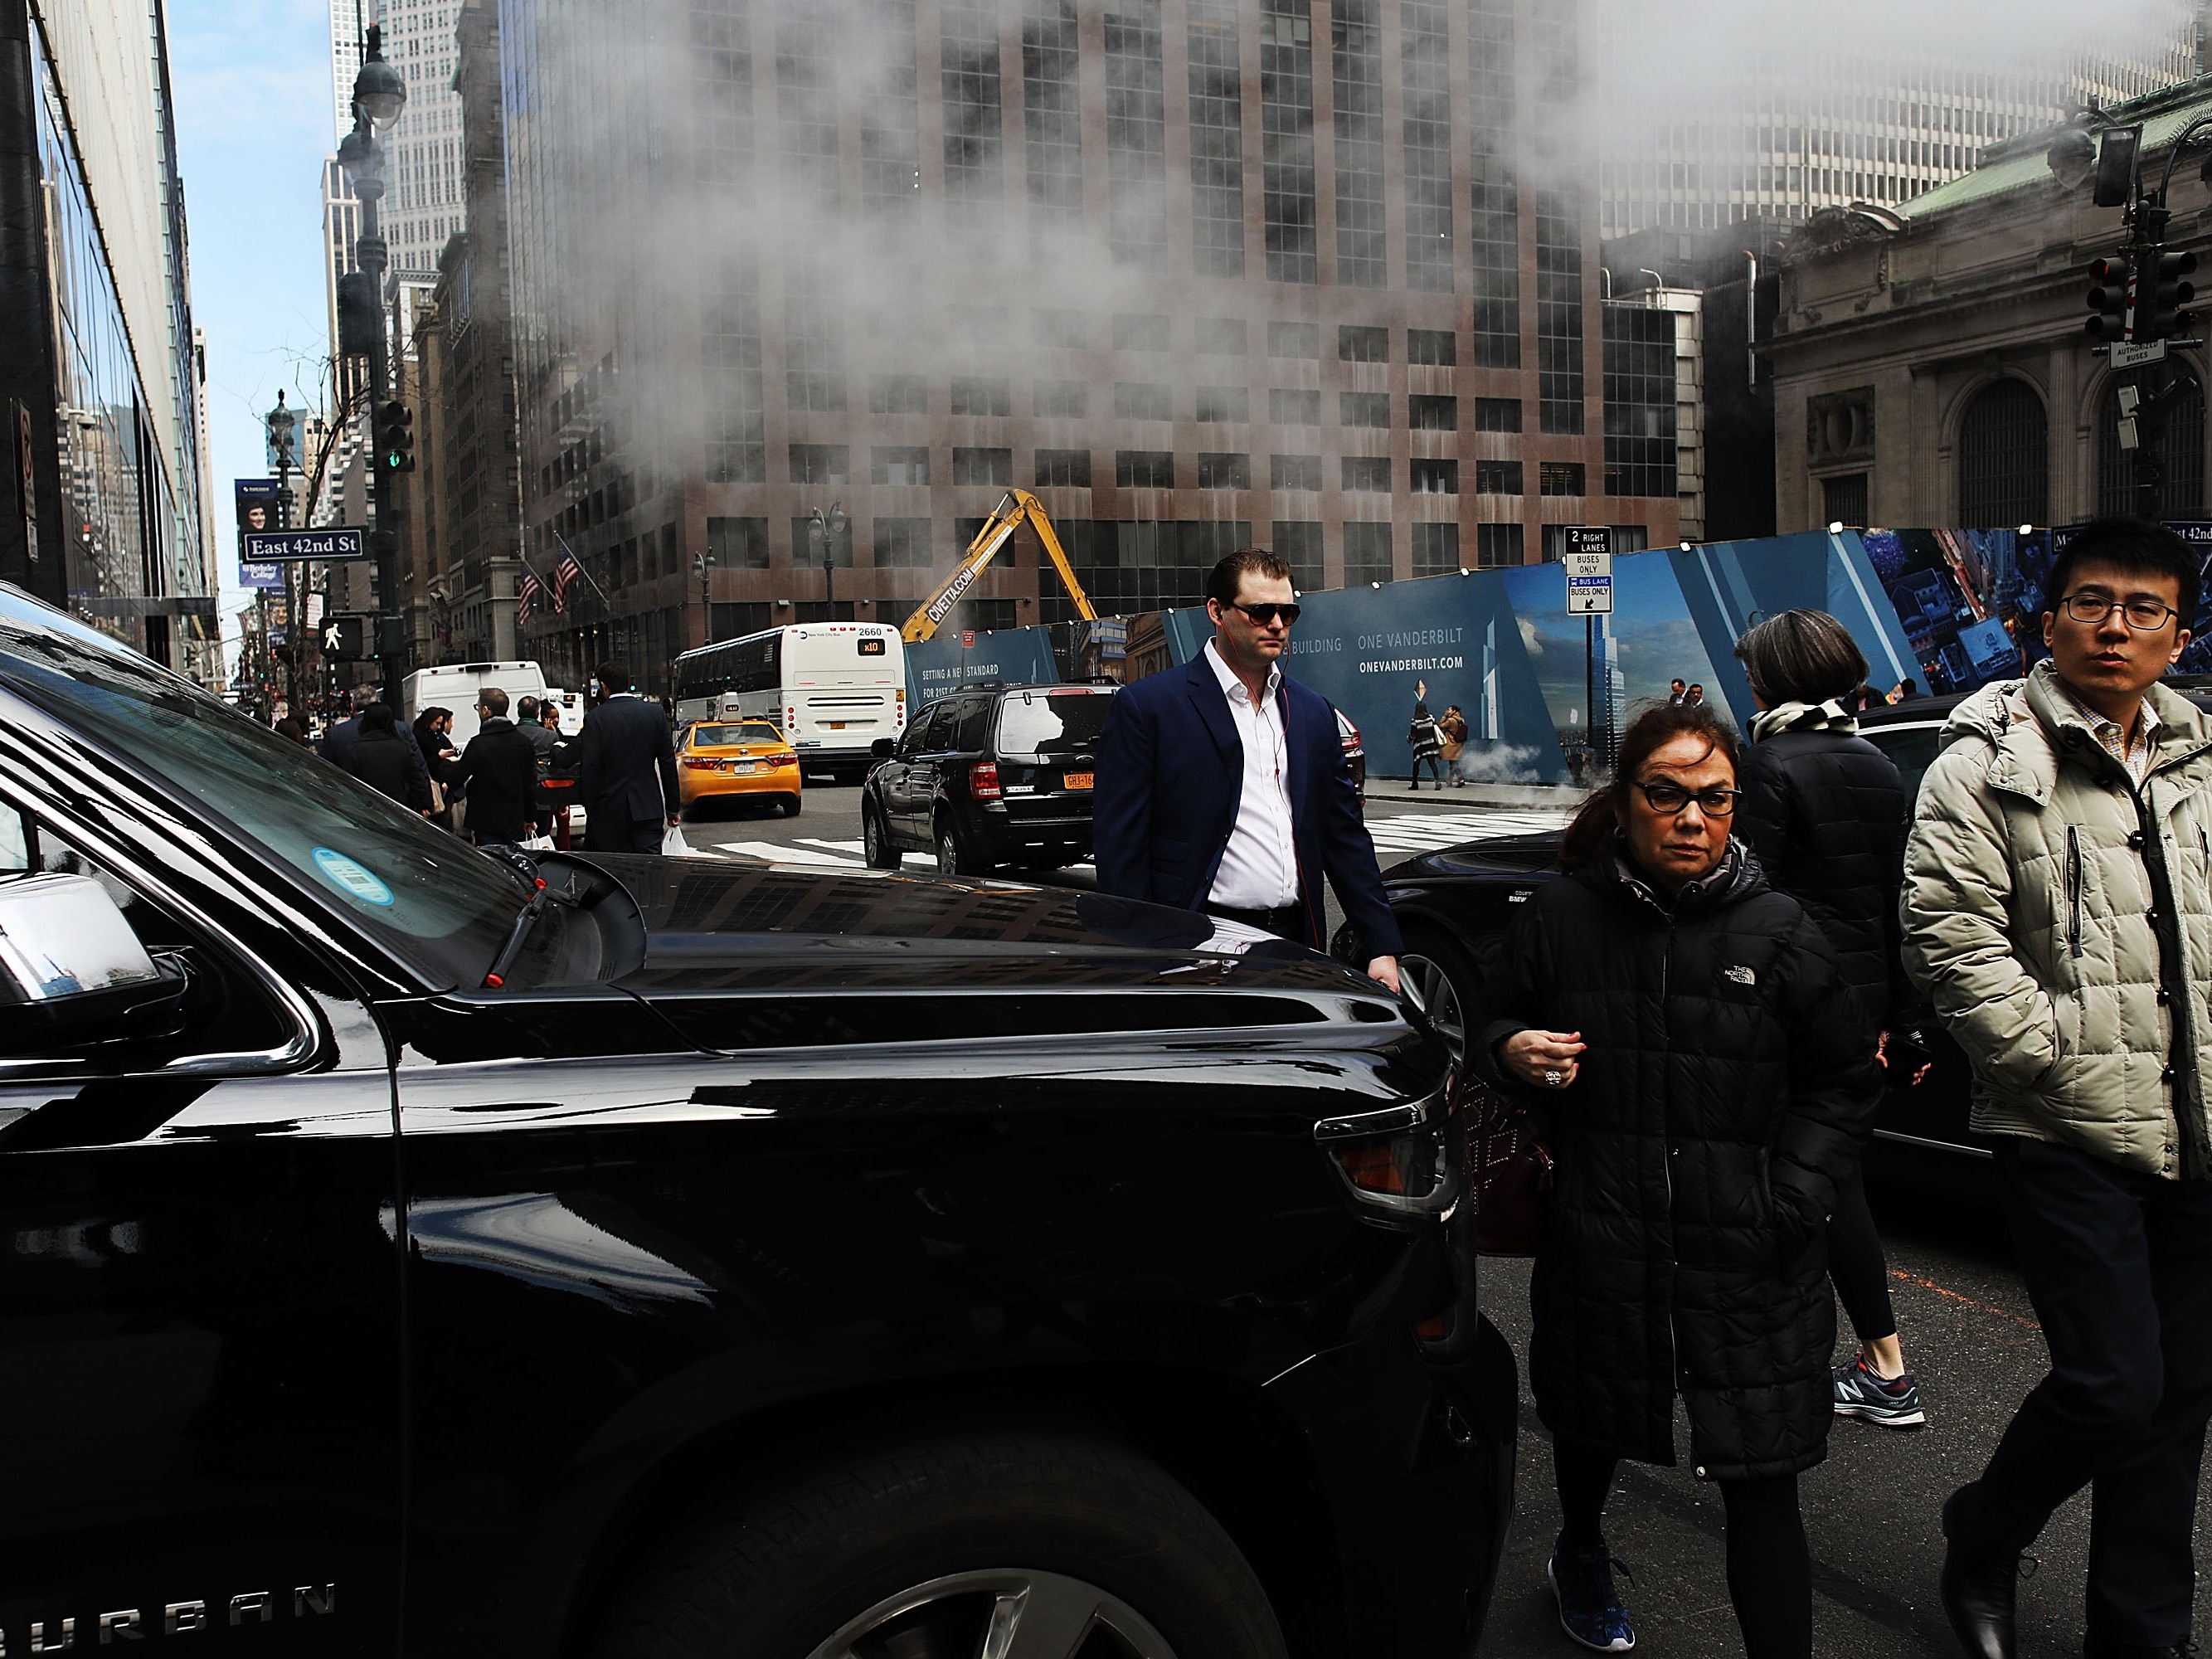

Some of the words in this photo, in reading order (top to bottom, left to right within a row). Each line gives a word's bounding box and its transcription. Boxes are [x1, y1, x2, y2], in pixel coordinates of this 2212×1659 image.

[2126, 351, 2148, 362] BUSES
[1572, 530, 1579, 542] 2
[1582, 533, 1604, 542] RIGHT
[2188, 527, 2212, 540] 42nd
[251, 539, 289, 555] East
[293, 538, 333, 554] 42nd
[338, 536, 357, 552] St
[1581, 543, 1606, 552] LANES
[1577, 555, 1600, 563] BUSES
[1579, 565, 1597, 573] ONLY
[928, 567, 975, 622] CIVETTA.COM
[1571, 587, 1591, 596] BUSES
[1592, 587, 1609, 596] ONLY
[858, 627, 882, 636] 2660
[1358, 634, 1383, 649] ONE
[1387, 627, 1464, 648] VANDERBILT
[1292, 637, 1342, 655] BUILDING
[1359, 656, 1463, 674] ONEVANDERBILT.COM
[922, 669, 945, 680] SETTING
[946, 669, 951, 679] A
[966, 664, 999, 677] STANDARD
[923, 688, 935, 698] FOR
[935, 687, 948, 698] 21ST
[1724, 970, 1746, 978] NORTH
[0, 1584, 334, 1658] URBAN
